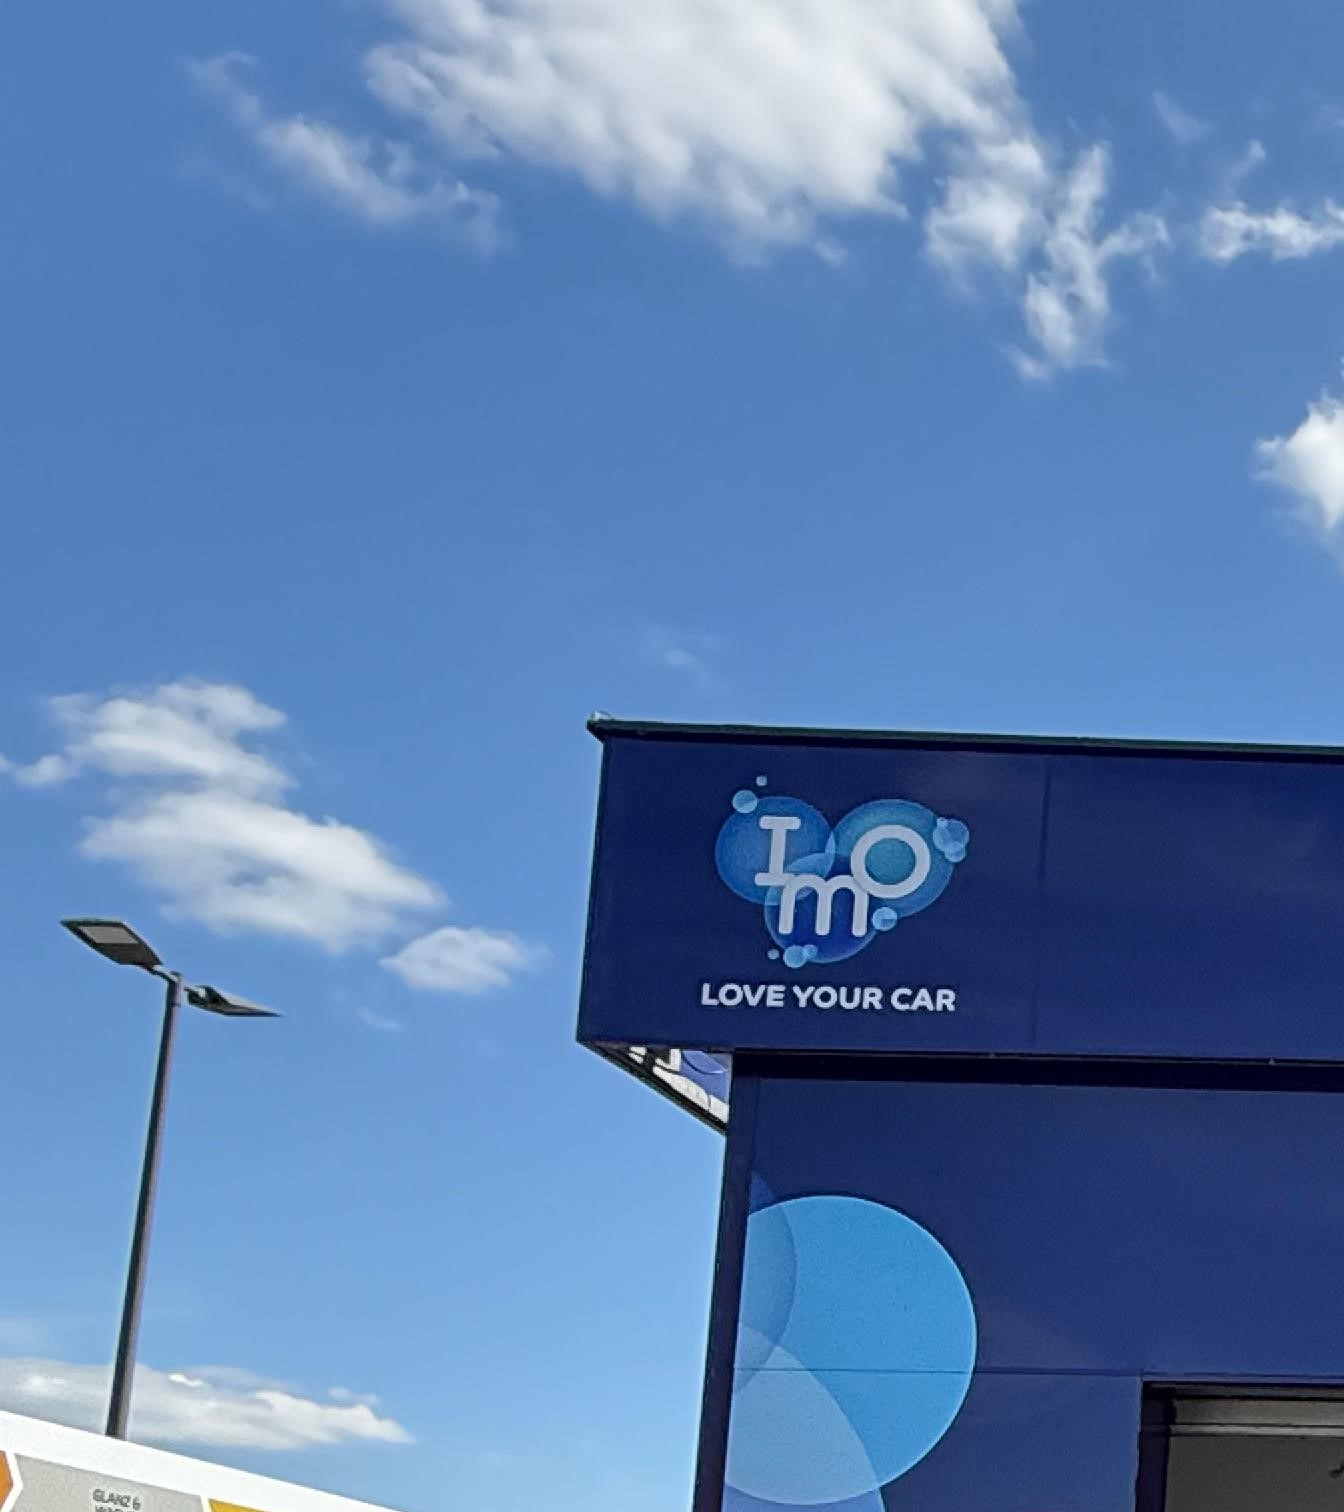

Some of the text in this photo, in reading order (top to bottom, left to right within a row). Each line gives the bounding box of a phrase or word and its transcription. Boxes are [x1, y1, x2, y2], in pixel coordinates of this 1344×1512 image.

[700, 981, 957, 1012] LOVE YOUR CAR
